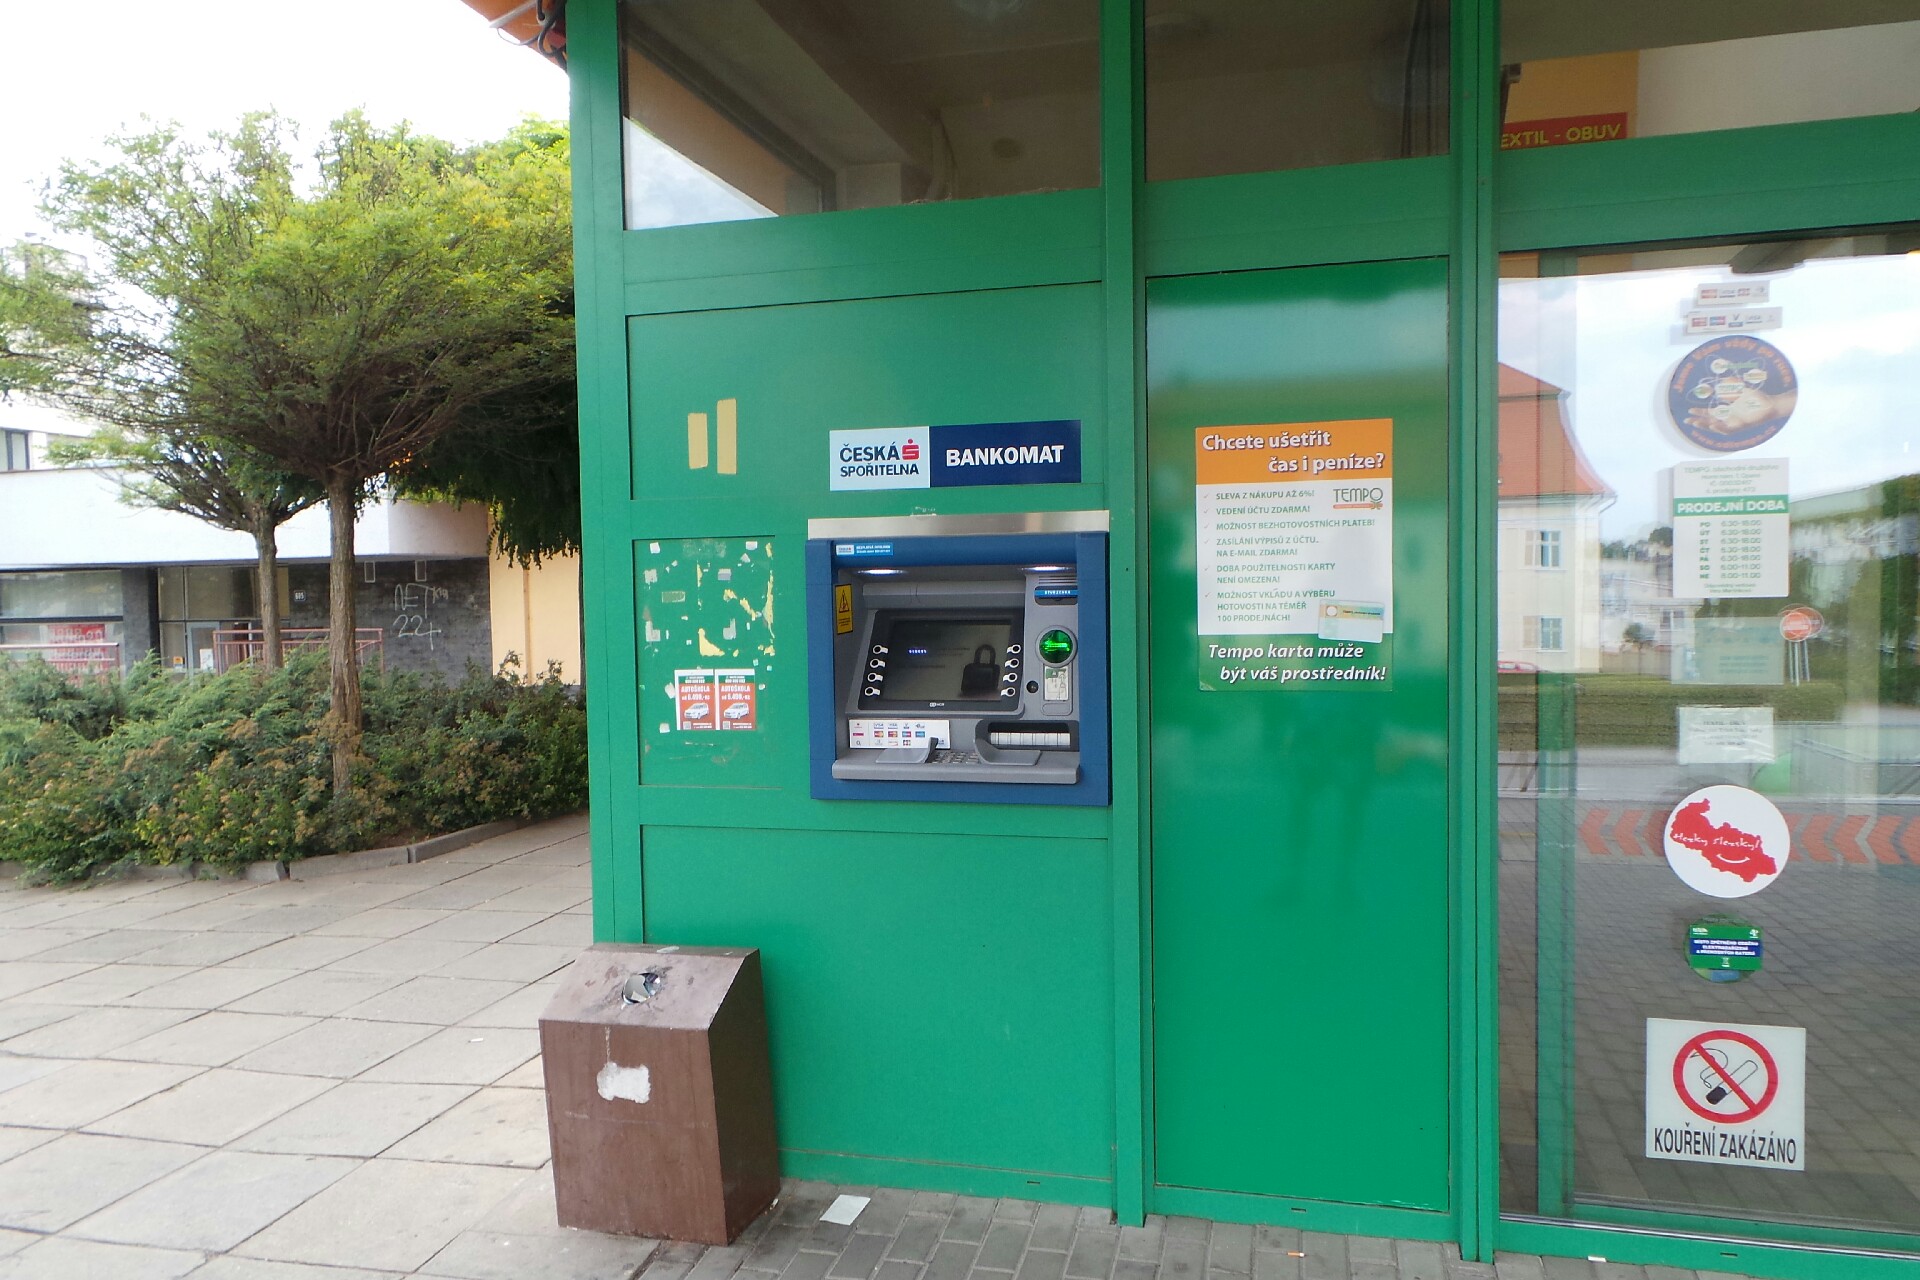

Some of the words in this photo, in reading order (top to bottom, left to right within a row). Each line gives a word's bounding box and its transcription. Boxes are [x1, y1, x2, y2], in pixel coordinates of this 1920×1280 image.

[1566, 123, 1621, 142] OBUV
[1202, 434, 1264, 450] Chcete
[1269, 430, 1331, 448] ušetřit
[840, 441, 900, 463] ČESKÁ
[946, 445, 1064, 467] BANKOMAT
[840, 463, 919, 477] SPOŘITELNA
[1268, 457, 1298, 472] čas
[1302, 455, 1308, 471] i
[1313, 452, 1385, 474] peníze?
[1216, 492, 1240, 500] SLEVA
[1249, 490, 1284, 499] NÁKUPU
[1286, 489, 1296, 498] AŽ
[1298, 489, 1315, 497] 6%!
[1333, 487, 1384, 502] TEMPO
[1216, 506, 1245, 515] VEDENÍ
[1247, 506, 1269, 514] ÚČTU
[1271, 505, 1310, 514] ZDARMA!
[1677, 499, 1744, 514] PRODEJNÍ
[1746, 500, 1786, 512] DOBA
[1216, 522, 1257, 530] MOŽNOST
[1258, 519, 1340, 529] BEZHOTOVOSTNÍCH
[1341, 519, 1375, 527] PLATEB!
[1216, 536, 1253, 545] ZASÍLÁNÍ
[1254, 535, 1284, 544] VÝPISŮ
[1285, 536, 1291, 544] Z
[1216, 549, 1228, 557] NA
[1230, 549, 1257, 557] E-MAIL
[1259, 548, 1298, 556] ZDARMA!
[1216, 564, 1240, 572] DOBA
[1241, 563, 1306, 572] POUŽITELNOSTI
[1308, 562, 1336, 571] KARTY
[1216, 575, 1236, 584] NENÍ
[1237, 576, 1280, 584] OMEZENA!
[1217, 590, 1257, 599] MOŽNOST
[1217, 602, 1264, 611] HOTOVOSTI
[1265, 602, 1278, 610] NA
[1233, 613, 1290, 622] PRODEJNÁCH!
[1208, 644, 1264, 660] Tempo
[1267, 643, 1314, 658] karta
[1317, 643, 1364, 658] může
[1220, 666, 1247, 683] být
[1250, 666, 1278, 680] váš
[1280, 665, 1386, 683] prostředník!
[1654, 1122, 1716, 1157] KOUŘENÍ
[1719, 1130, 1796, 1164] ZAKÁZÁNO
